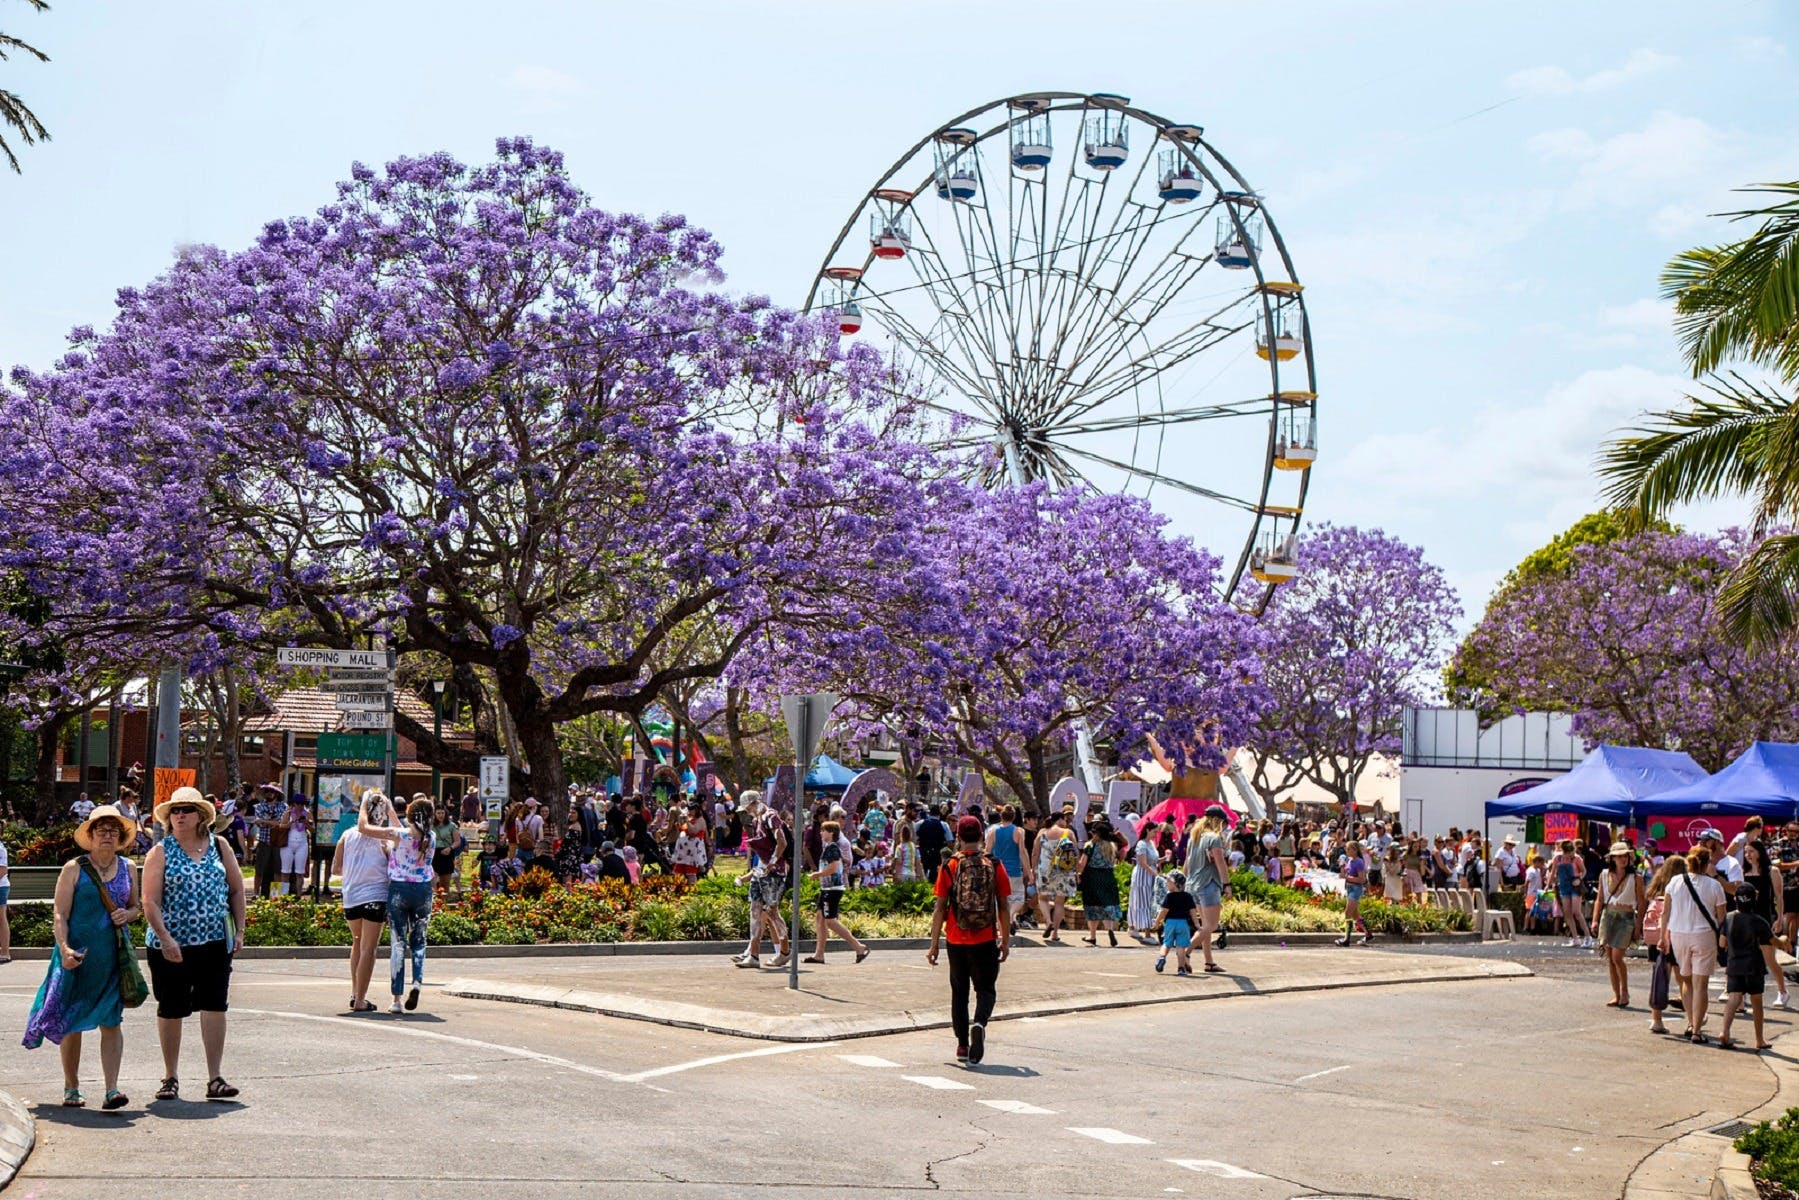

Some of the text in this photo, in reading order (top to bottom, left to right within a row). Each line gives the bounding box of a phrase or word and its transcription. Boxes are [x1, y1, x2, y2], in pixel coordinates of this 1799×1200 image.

[287, 650, 378, 666] SHOPPING MALL
[333, 671, 386, 680] MOTOR REGISTRY
[338, 683, 359, 692] CROSS
[338, 693, 375, 704] JACARANDA
[346, 712, 384, 722] POUND ST
[155, 768, 192, 786] SNOW
[1546, 812, 1577, 828] SNOW
[1546, 831, 1576, 841] CONES
